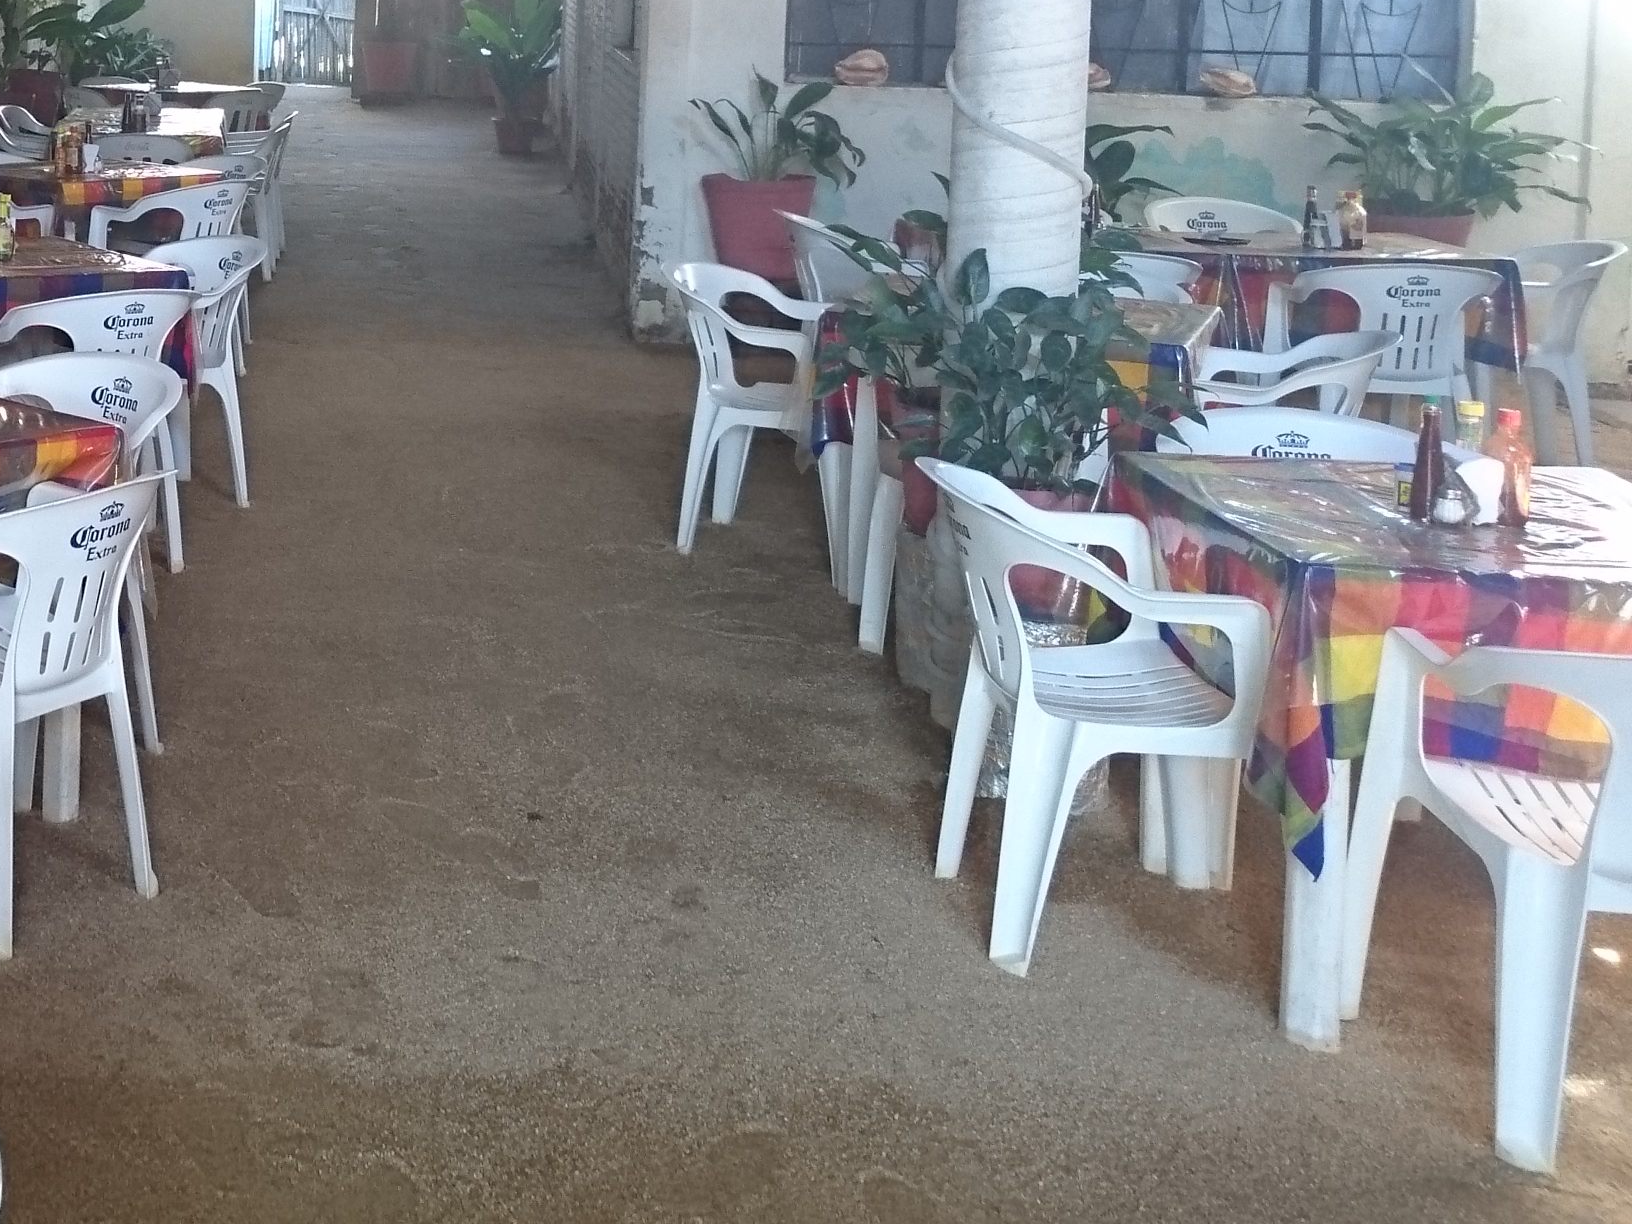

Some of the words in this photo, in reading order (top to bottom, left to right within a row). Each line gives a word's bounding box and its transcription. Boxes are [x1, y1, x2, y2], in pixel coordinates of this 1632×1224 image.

[1186, 218, 1228, 231] Corona
[1386, 285, 1441, 301] Corona
[1401, 298, 1431, 308] Extra
[103, 314, 154, 332] Corona
[117, 330, 144, 340] Extra
[90, 385, 139, 413] Corona
[102, 405, 128, 425] Extra
[69, 517, 132, 551] Corona
[86, 544, 118, 562] Extra
